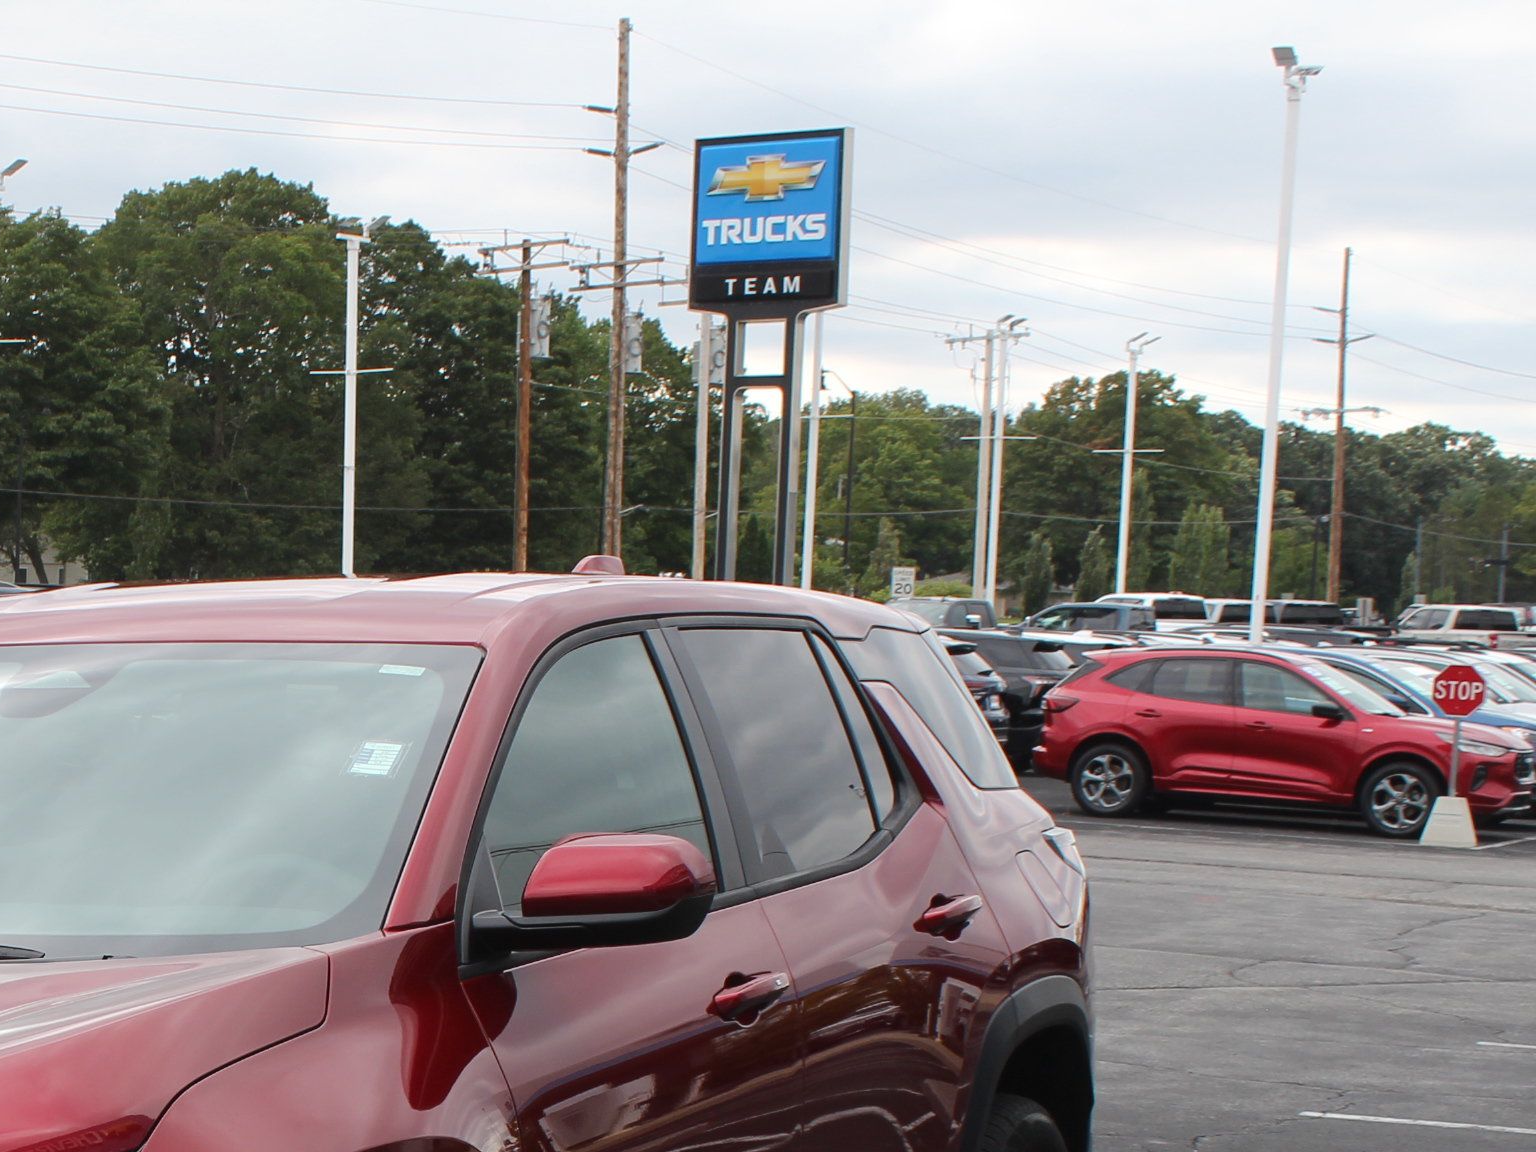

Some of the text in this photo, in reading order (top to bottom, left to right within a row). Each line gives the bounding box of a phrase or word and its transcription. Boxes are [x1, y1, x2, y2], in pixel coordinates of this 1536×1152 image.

[702, 213, 826, 246] TRUCKS
[725, 275, 801, 296] TEAM
[895, 583, 912, 594] 20
[1435, 680, 1484, 700] STOP
